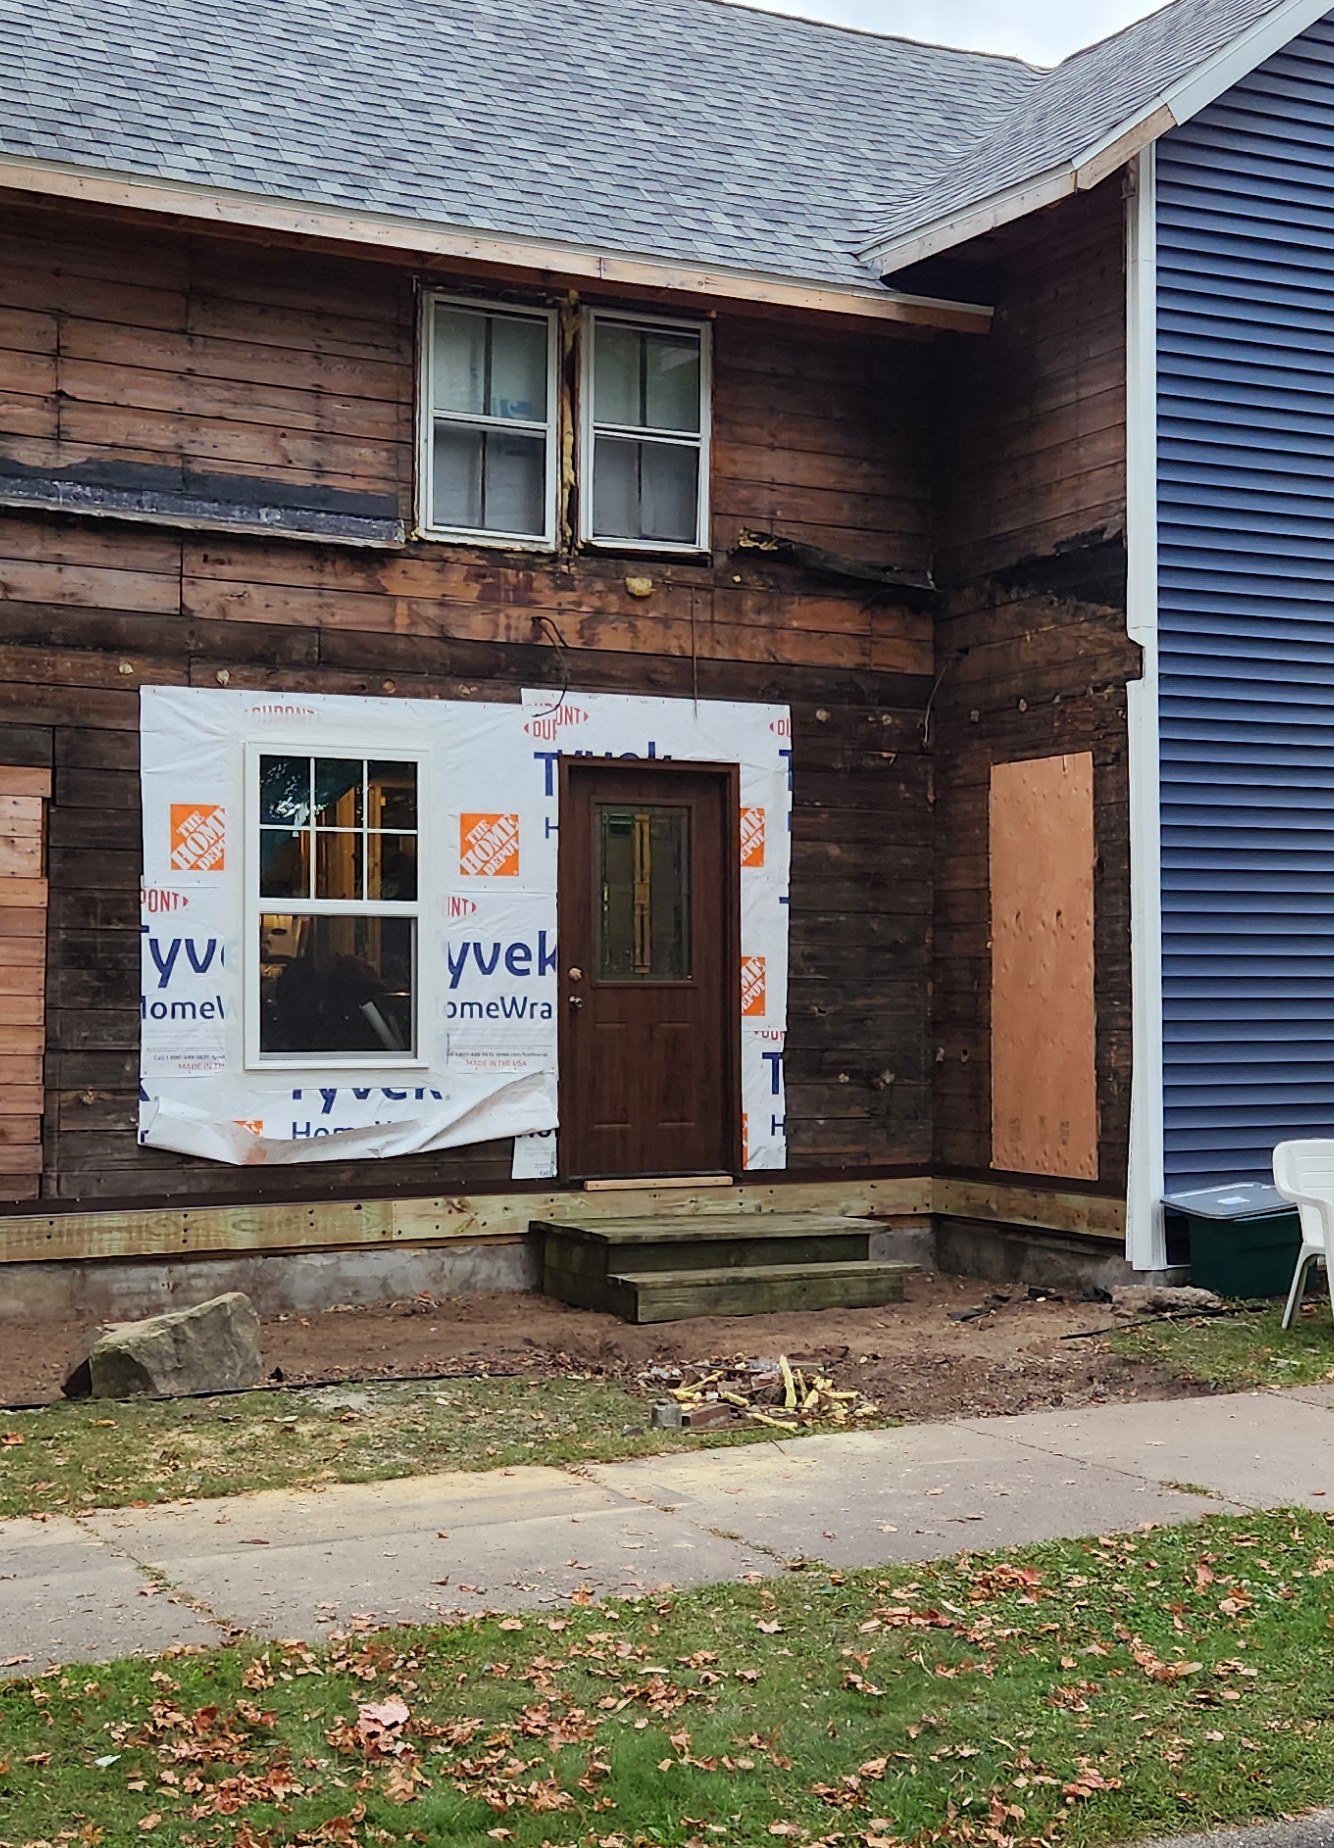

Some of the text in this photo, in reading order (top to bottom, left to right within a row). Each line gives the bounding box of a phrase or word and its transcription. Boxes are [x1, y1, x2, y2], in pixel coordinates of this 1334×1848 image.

[460, 814, 519, 876] HOME
[464, 819, 492, 846] THE
[482, 836, 519, 876] DEPOT
